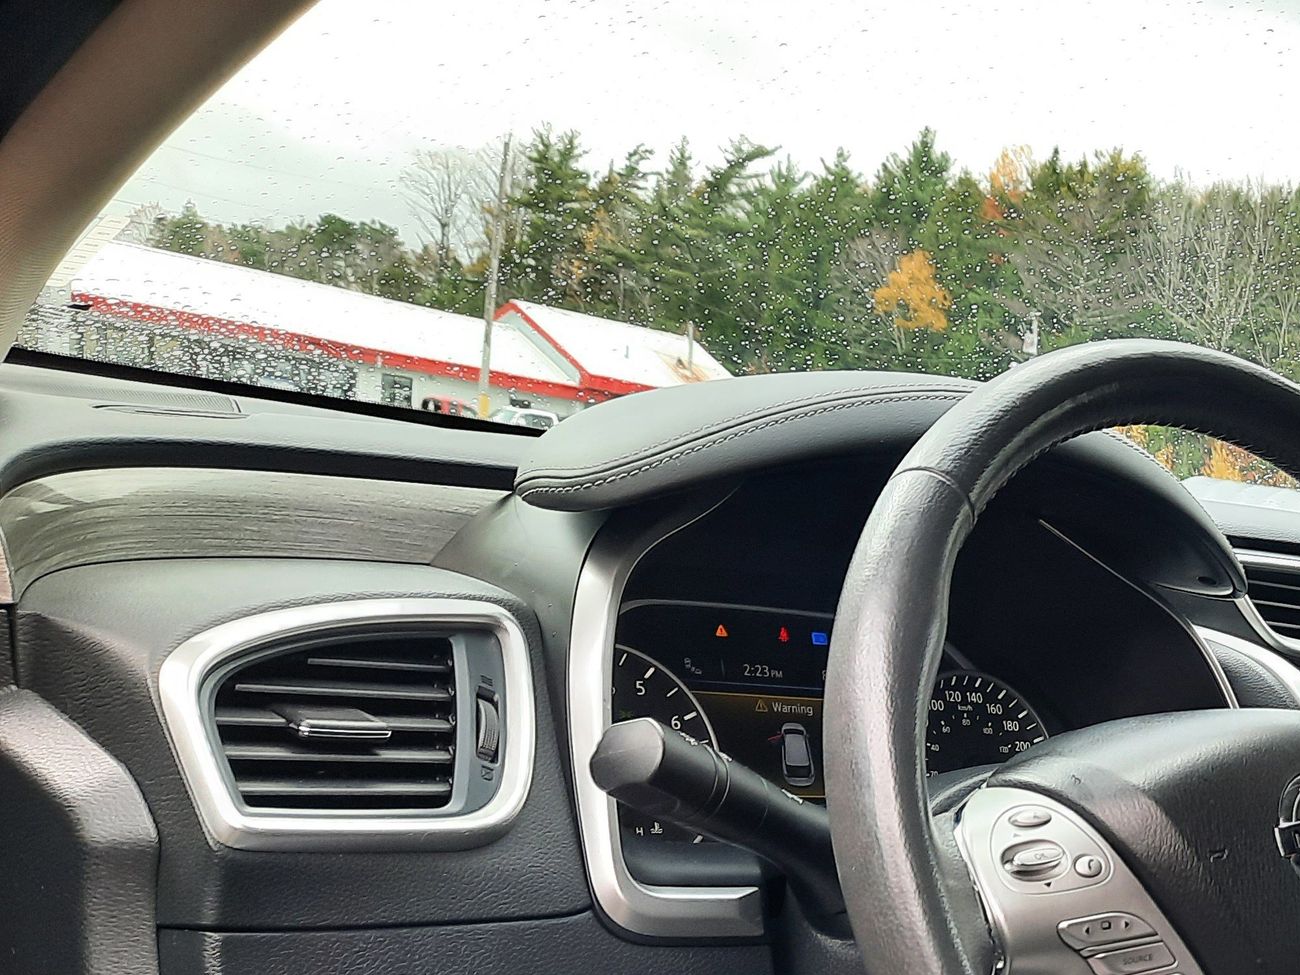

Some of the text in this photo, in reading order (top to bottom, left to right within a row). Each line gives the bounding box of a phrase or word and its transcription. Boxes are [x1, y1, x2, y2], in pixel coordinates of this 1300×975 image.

[635, 680, 646, 696] 5
[945, 690, 961, 702] 120
[966, 692, 983, 703] 140
[772, 702, 813, 716] Warning
[986, 703, 1002, 715] 160
[671, 715, 681, 730] 6
[1002, 720, 1019, 732] 180
[1015, 740, 1031, 752] 200
